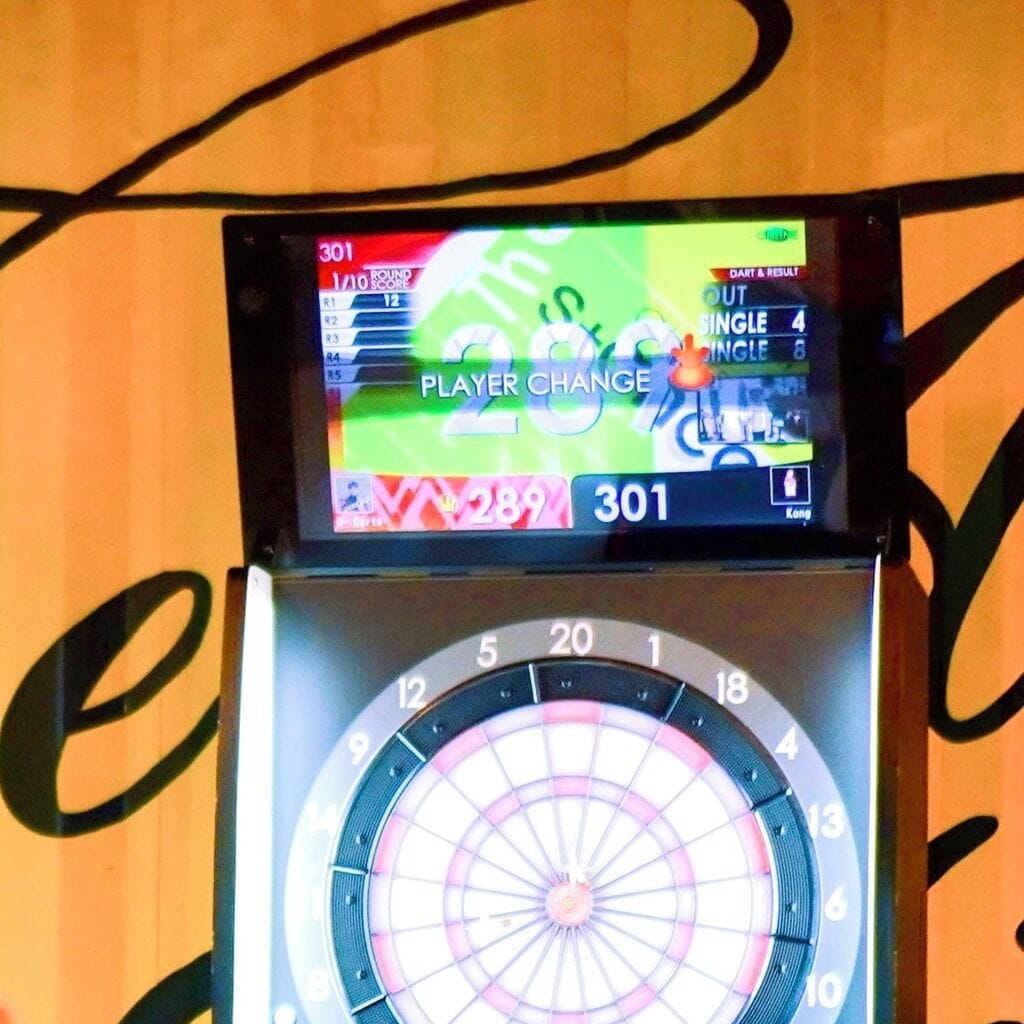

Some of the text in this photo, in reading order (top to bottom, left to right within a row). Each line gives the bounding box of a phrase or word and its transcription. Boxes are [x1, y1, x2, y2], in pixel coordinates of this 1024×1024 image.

[319, 242, 353, 262] 301
[333, 272, 368, 291] 1/10
[370, 269, 412, 281] ROUND
[370, 280, 410, 290] SCORE
[729, 267, 799, 278] DART & RESULT
[323, 294, 400, 308] R1 12
[702, 285, 747, 306] OUT
[325, 316, 338, 326] R2
[699, 310, 806, 335] SINGLE 4
[326, 334, 339, 344] R3
[793, 339, 806, 359] 8
[327, 352, 340, 363] R4
[327, 370, 341, 380] R5
[421, 369, 651, 398] PLAYER CHANGE
[469, 486, 547, 525] 289
[594, 482, 668, 523] 301
[476, 635, 498, 668] 5
[549, 622, 593, 655] 20
[647, 635, 661, 667] 1
[396, 677, 427, 709] 12
[714, 671, 749, 705] 18
[348, 732, 369, 765] 9
[774, 726, 799, 760] 4
[808, 804, 844, 838] 13
[825, 889, 847, 921] 6
[807, 974, 842, 1009] 10
